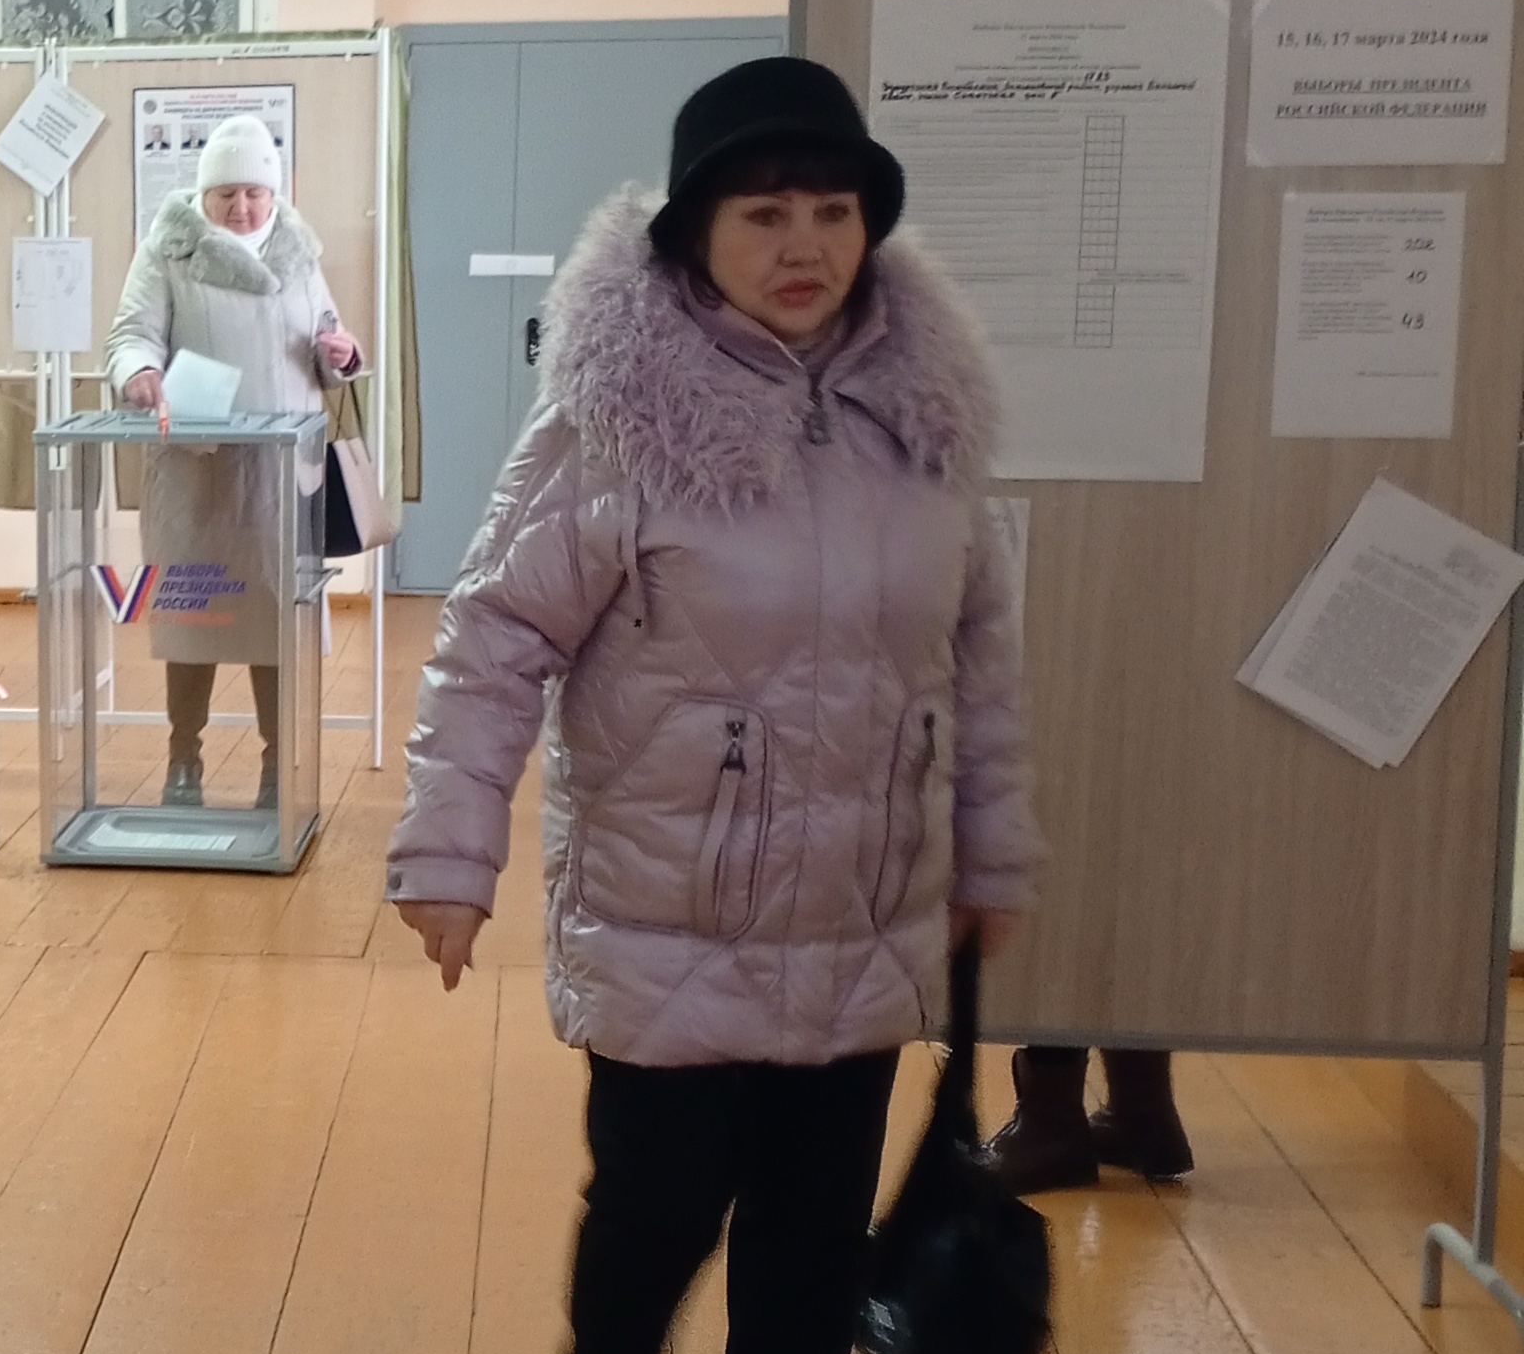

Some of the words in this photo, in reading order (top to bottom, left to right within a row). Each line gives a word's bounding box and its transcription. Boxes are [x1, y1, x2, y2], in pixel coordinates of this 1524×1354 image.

[1332, 31, 1350, 46] 17
[1409, 30, 1448, 45] 2024
[1276, 101, 1385, 117] РОССИЙСКОЙ
[1388, 100, 1488, 117] ФЕДЕРАЦИИ
[166, 564, 228, 578] ВЫБОРЫ
[159, 580, 247, 595] ПРЕЗИДЕНТА
[152, 597, 210, 610] РОССИИ
